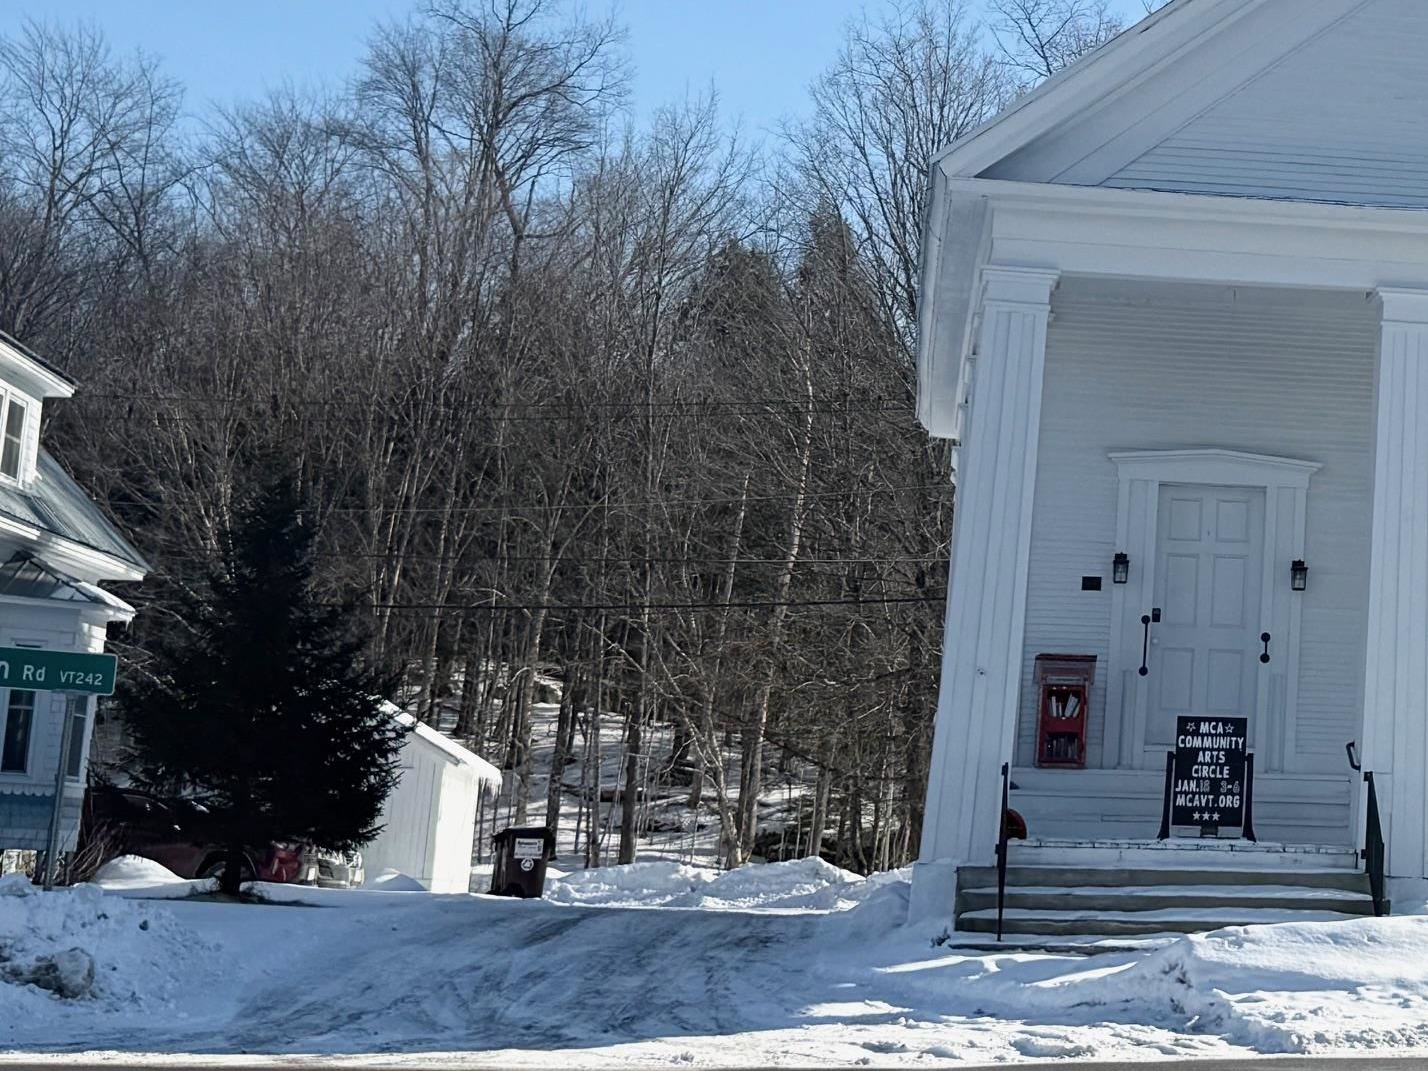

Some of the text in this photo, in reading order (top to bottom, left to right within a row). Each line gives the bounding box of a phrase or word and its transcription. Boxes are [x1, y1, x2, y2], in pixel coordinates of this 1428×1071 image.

[23, 664, 46, 681] Rd
[60, 670, 103, 685] VT242
[1199, 721, 1224, 734] MCA
[1178, 735, 1244, 750] COMMUNITY
[1197, 750, 1226, 763] ARTS
[1191, 765, 1230, 779] CIRCLE
[1175, 794, 1240, 807] MCAVT.ORG
